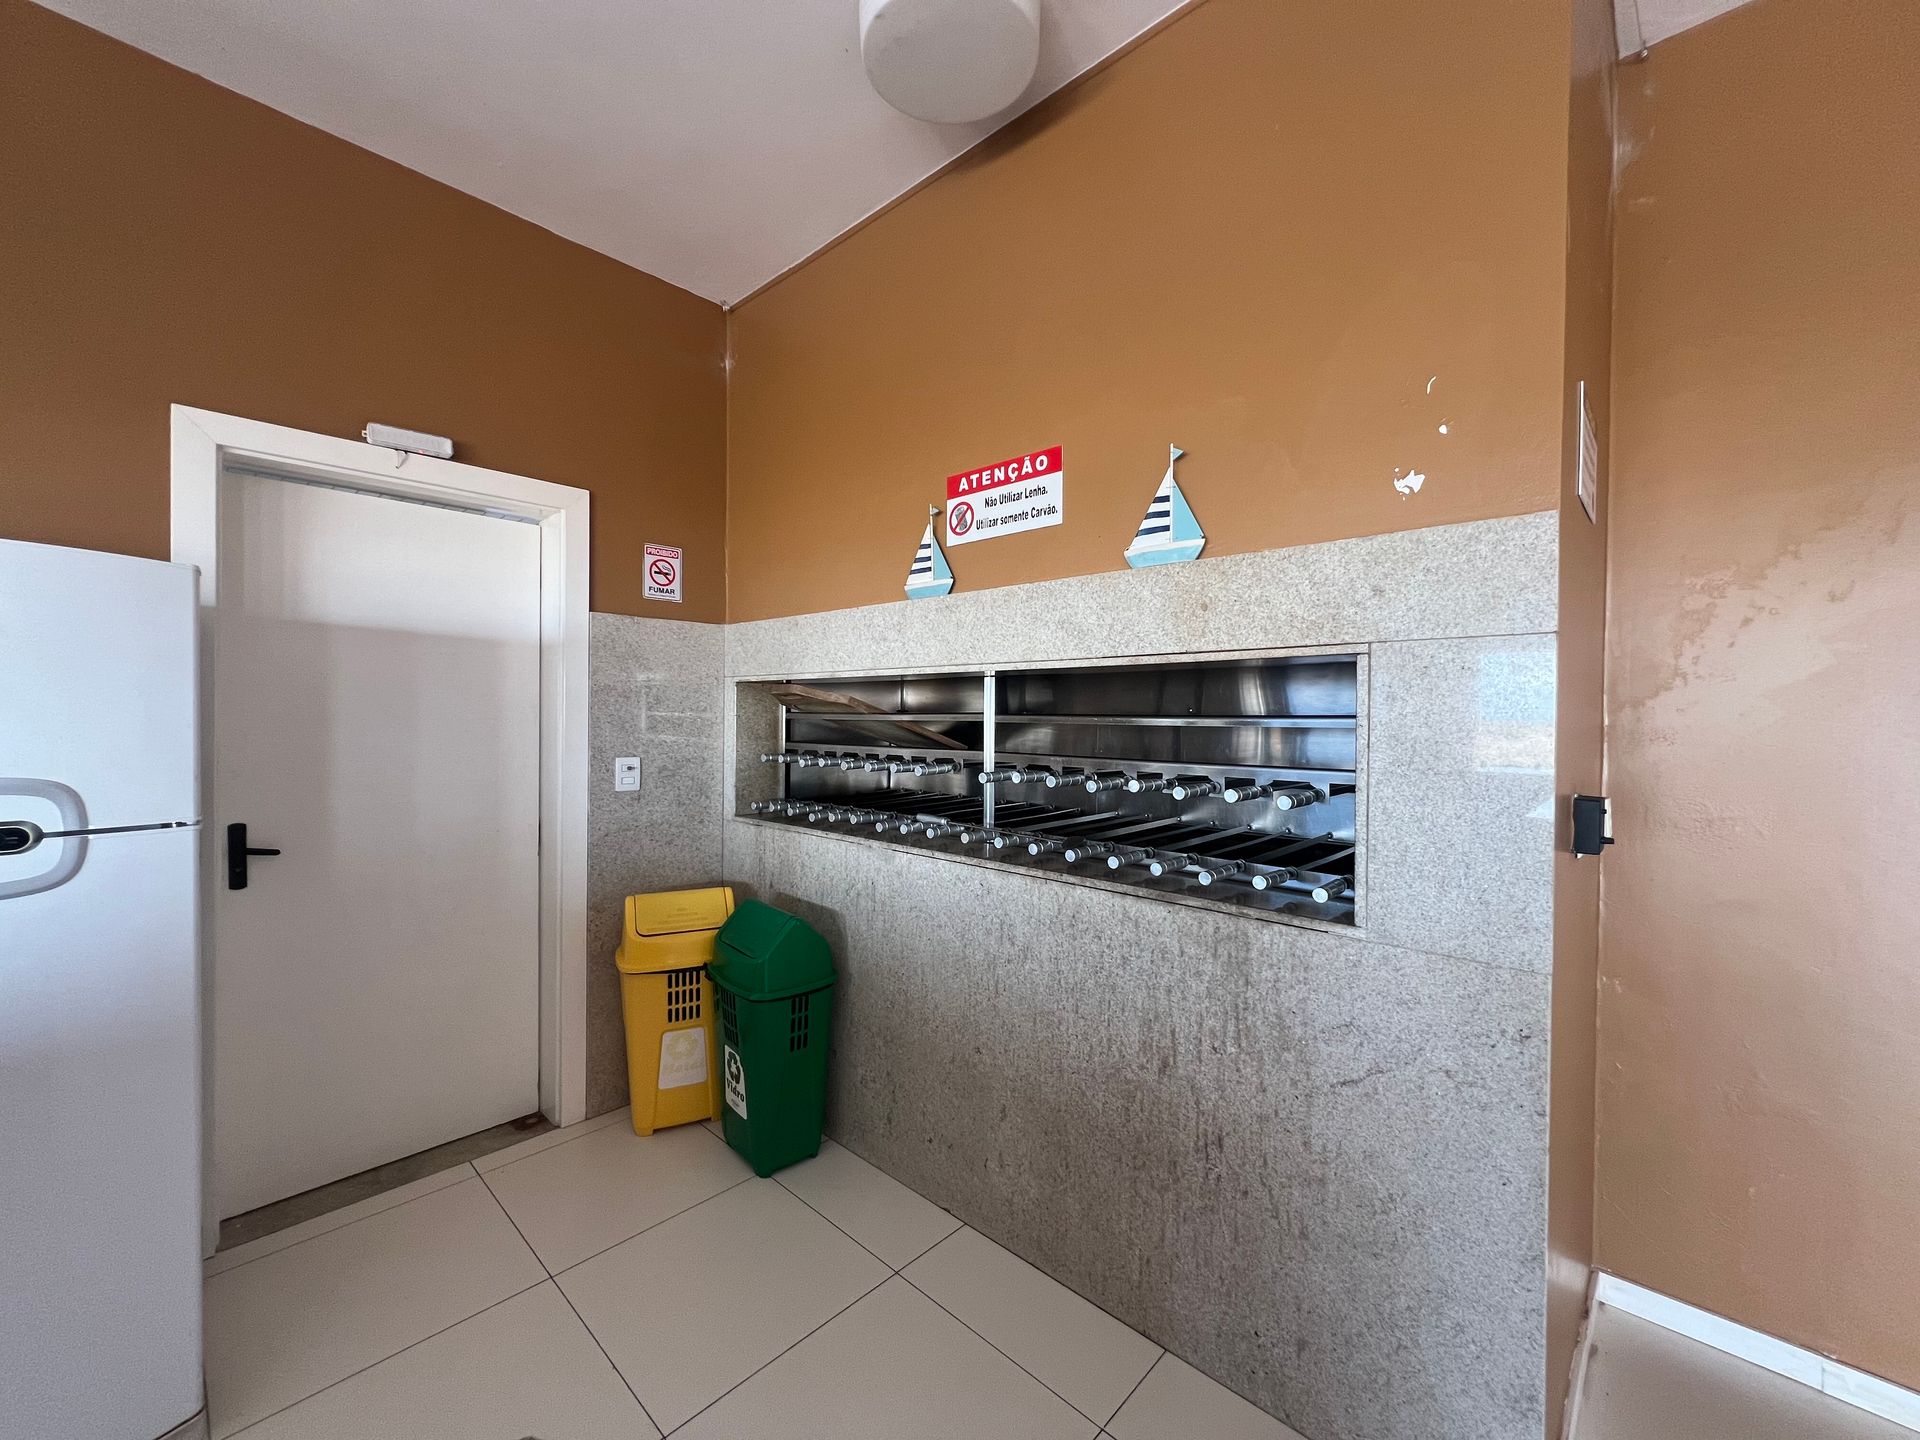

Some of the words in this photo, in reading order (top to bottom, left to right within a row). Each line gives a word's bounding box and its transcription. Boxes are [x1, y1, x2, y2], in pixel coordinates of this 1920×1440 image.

[958, 455, 1048, 492] ATENÇÃO
[984, 497, 998, 509] Não
[998, 491, 1023, 505] Utilizar
[1024, 485, 1048, 499] Lenha.
[976, 517, 999, 530] Utilizar
[1000, 511, 1029, 525] somente
[1030, 504, 1058, 519] Carvão.
[648, 586, 676, 594] FUMAR
[726, 1077, 744, 1102] Vidro
